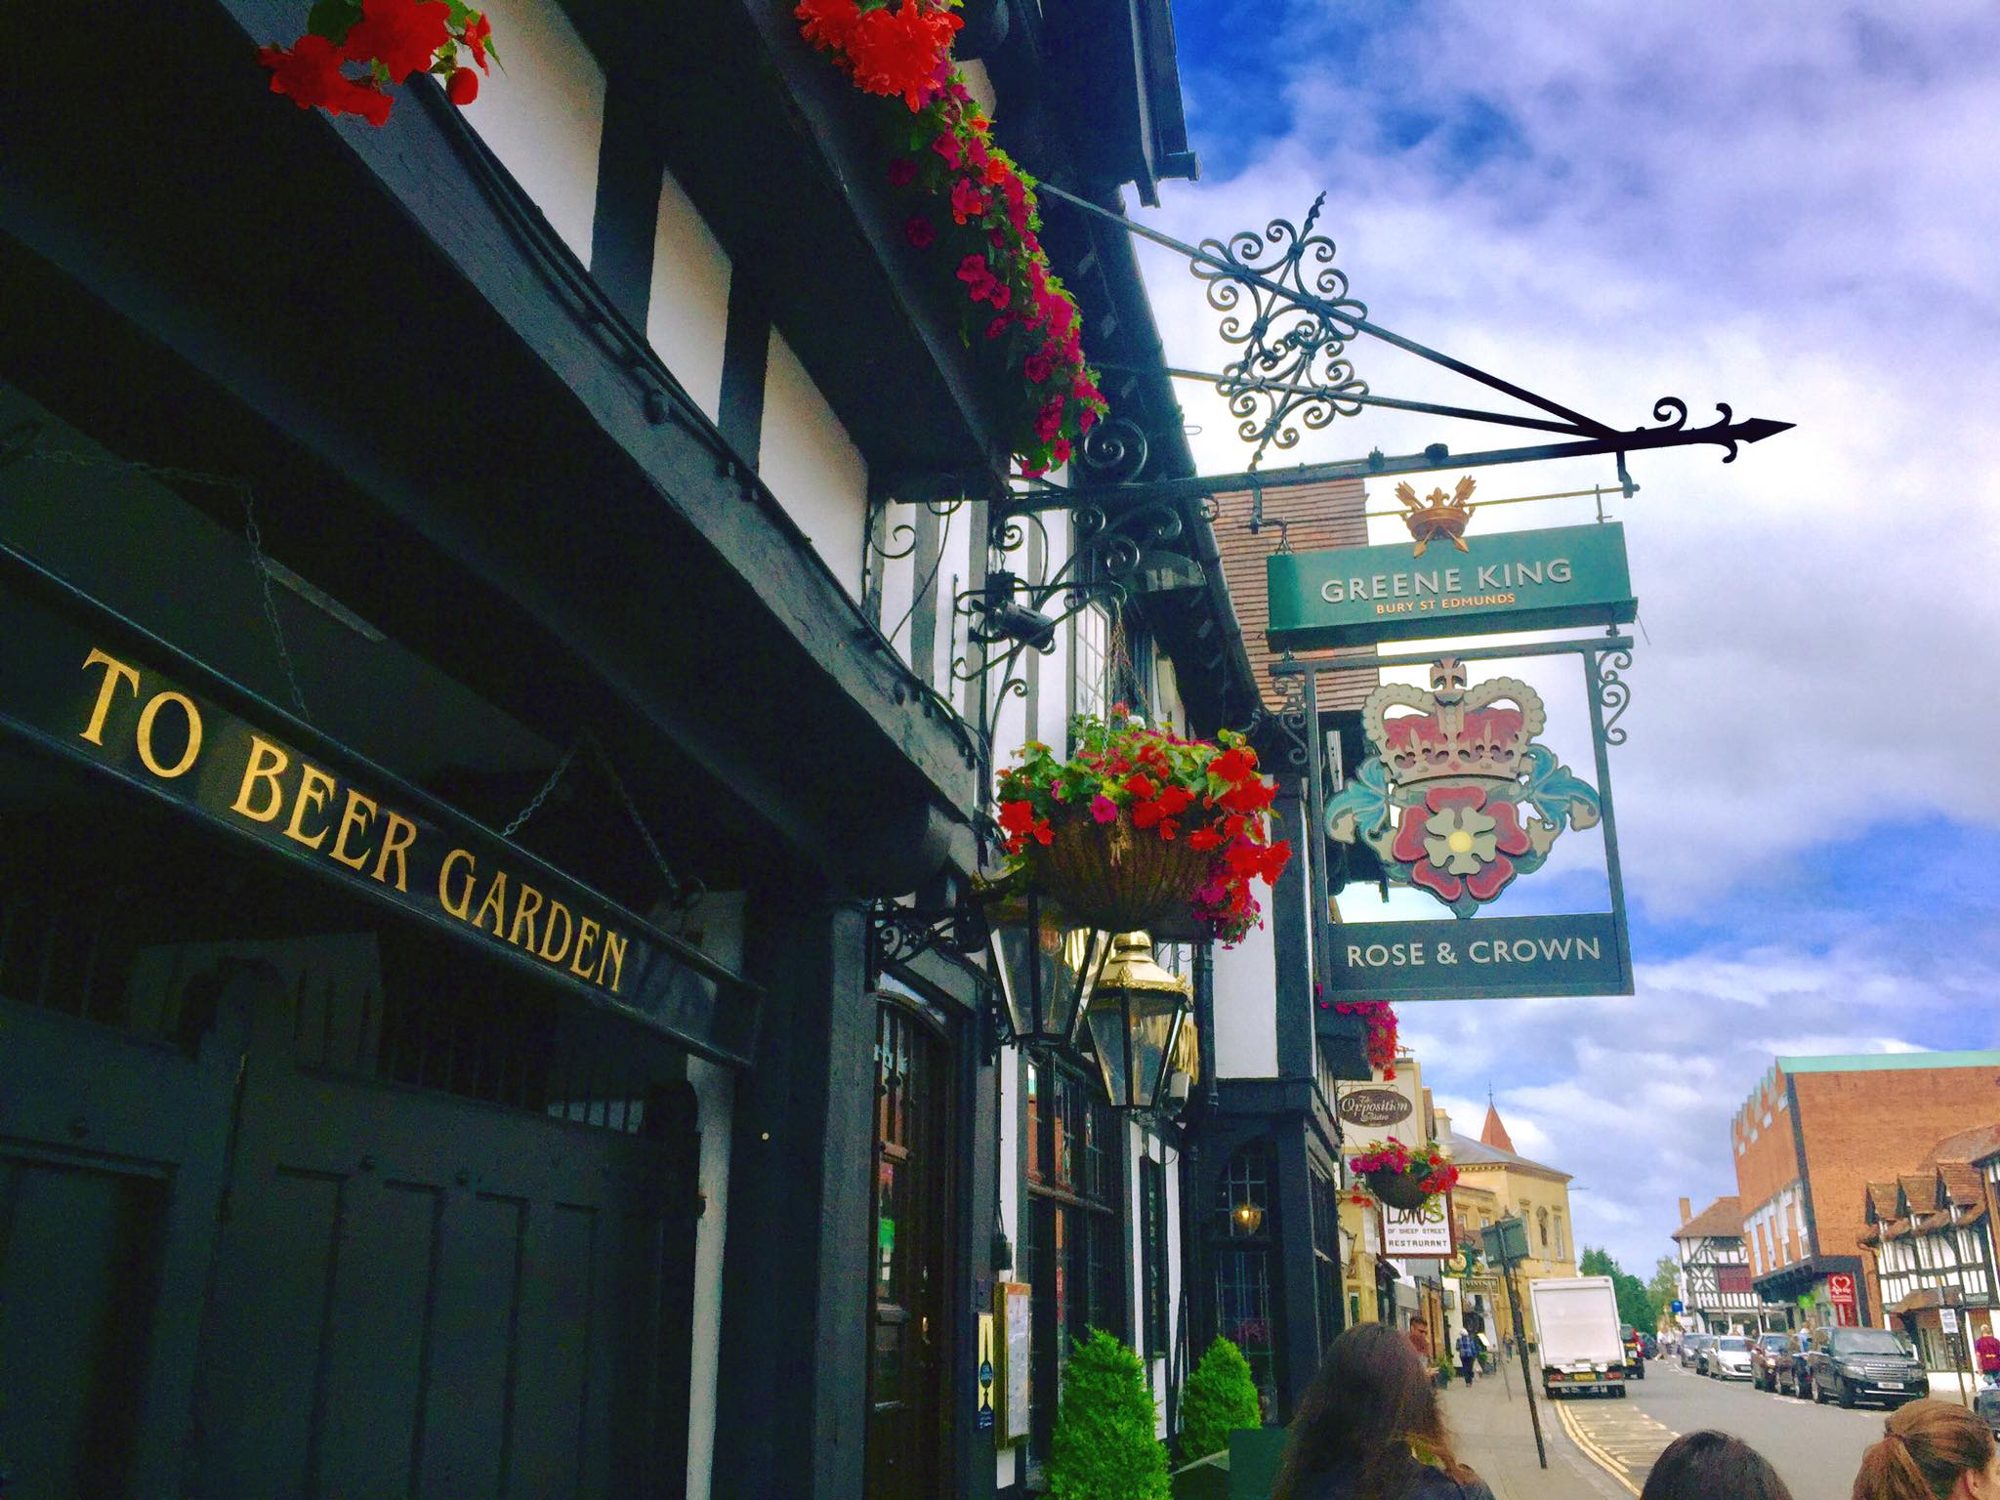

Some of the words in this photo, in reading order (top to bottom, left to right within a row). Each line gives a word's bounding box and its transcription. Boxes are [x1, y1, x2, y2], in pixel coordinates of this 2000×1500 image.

[1321, 568, 1462, 604] GREENE
[1477, 558, 1573, 591] KING
[1376, 601, 1415, 615] BURY
[1420, 599, 1436, 611] ST
[1442, 593, 1516, 610] EDMUNDS
[79, 647, 203, 778] TO
[230, 735, 418, 894] BEER
[438, 848, 629, 993] GARDEN
[1347, 942, 1425, 968] ROSE
[1436, 941, 1458, 965] &
[1468, 937, 1601, 964] CROWN
[1341, 1098, 1408, 1122] Opposition
